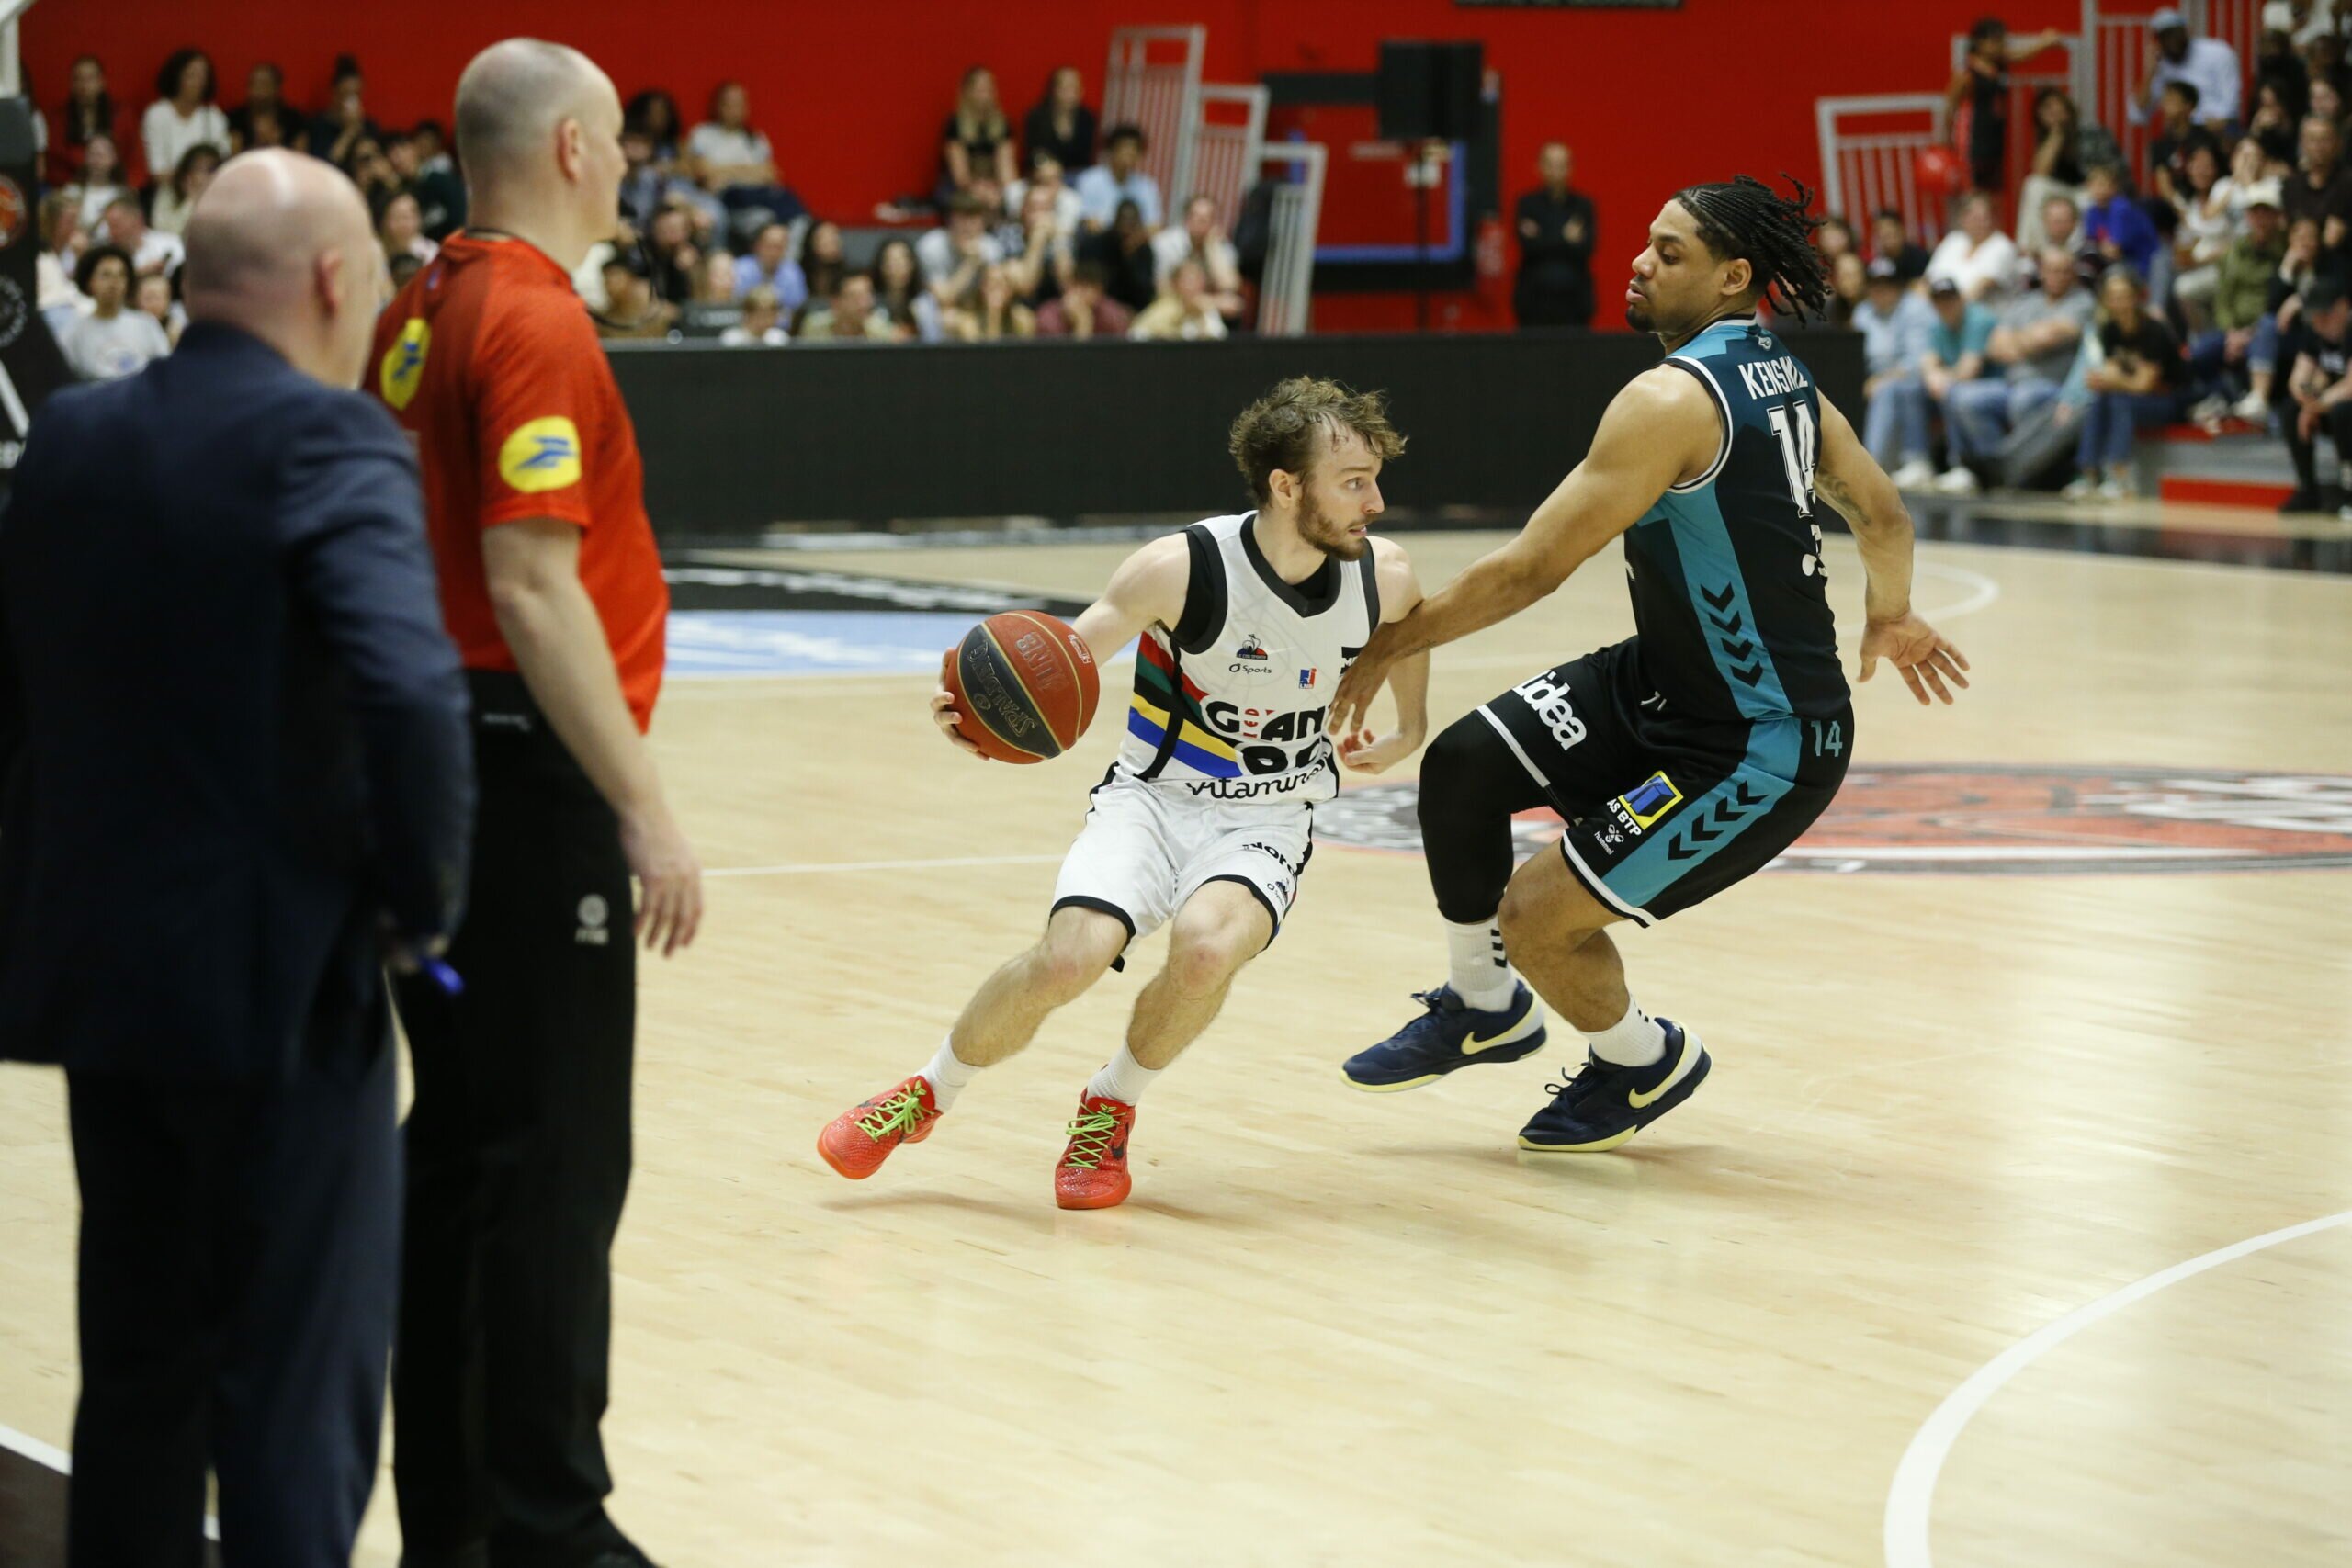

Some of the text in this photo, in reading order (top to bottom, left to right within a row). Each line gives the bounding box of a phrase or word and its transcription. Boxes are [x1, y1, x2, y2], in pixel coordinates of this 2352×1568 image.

[1242, 665, 1272, 674] Sports
[1811, 720, 1843, 757] 14
[1606, 798, 1642, 835] AS BTP
[1594, 830, 1614, 855] hummel
